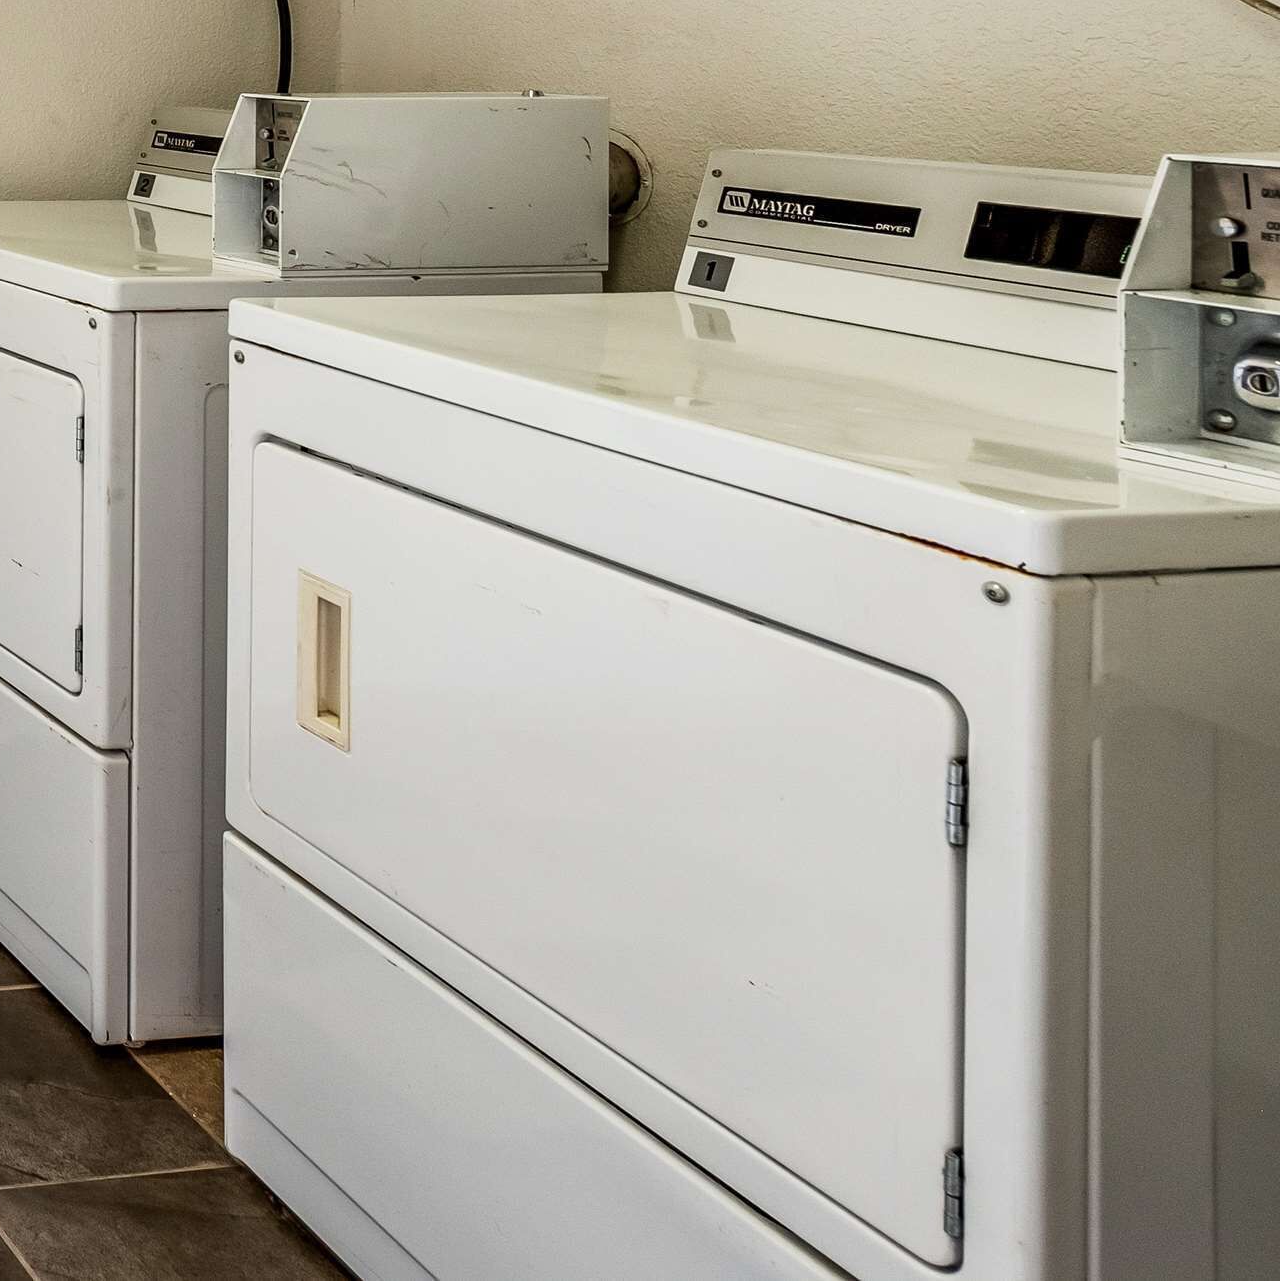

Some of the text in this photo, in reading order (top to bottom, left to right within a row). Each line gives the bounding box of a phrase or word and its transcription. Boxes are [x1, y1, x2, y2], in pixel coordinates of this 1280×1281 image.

[140, 178, 150, 192] 2
[750, 197, 815, 217] MAYTAG
[748, 209, 813, 222] COMMERCIAL
[875, 222, 911, 234] DRYER
[1266, 221, 1280, 231] CO
[704, 259, 717, 283] 1
